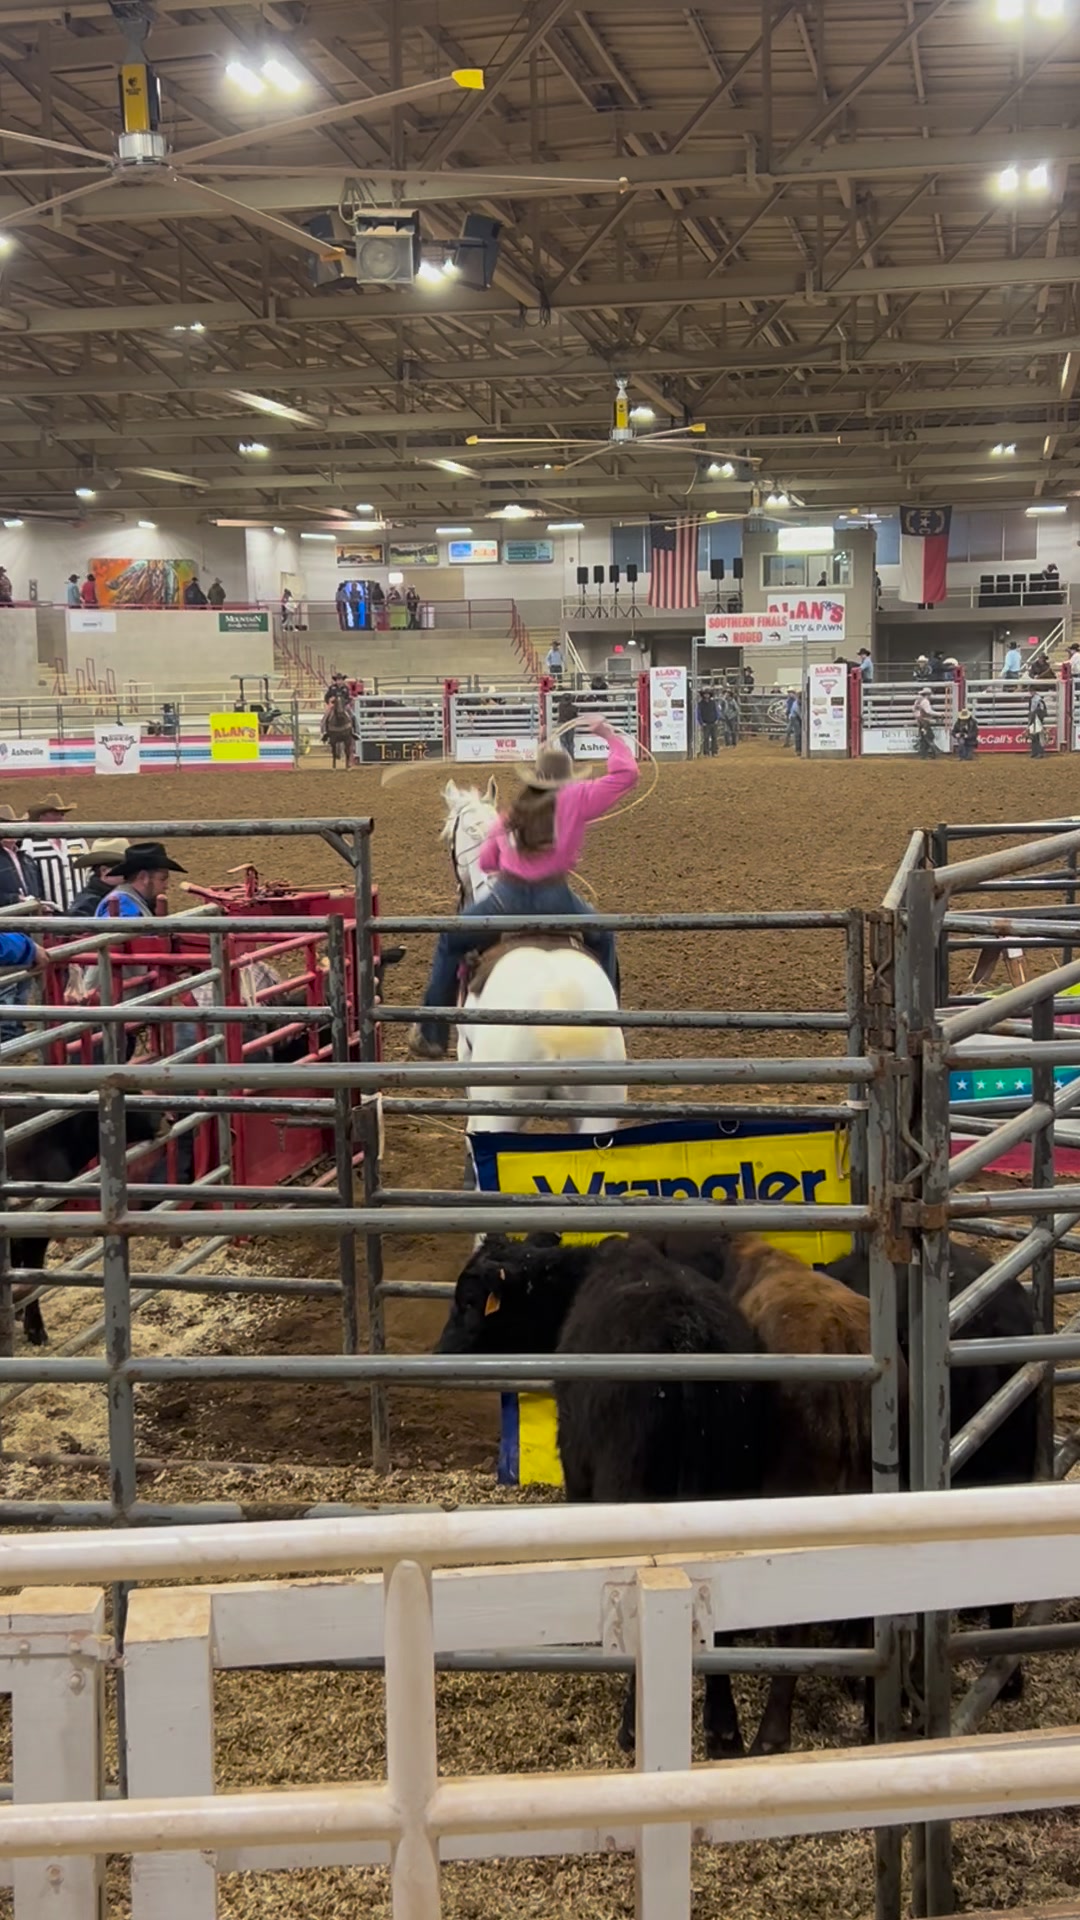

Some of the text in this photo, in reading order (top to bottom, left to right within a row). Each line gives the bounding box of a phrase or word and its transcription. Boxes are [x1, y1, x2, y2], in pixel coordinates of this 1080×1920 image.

[708, 615, 788, 629] SOUTHERN FINALS
[732, 632, 763, 643] RODEO
[214, 726, 256, 738] ALAN'S
[495, 739, 517, 747] WCB
[580, 743, 609, 751] Ashev
[11, 748, 44, 756] Asheville
